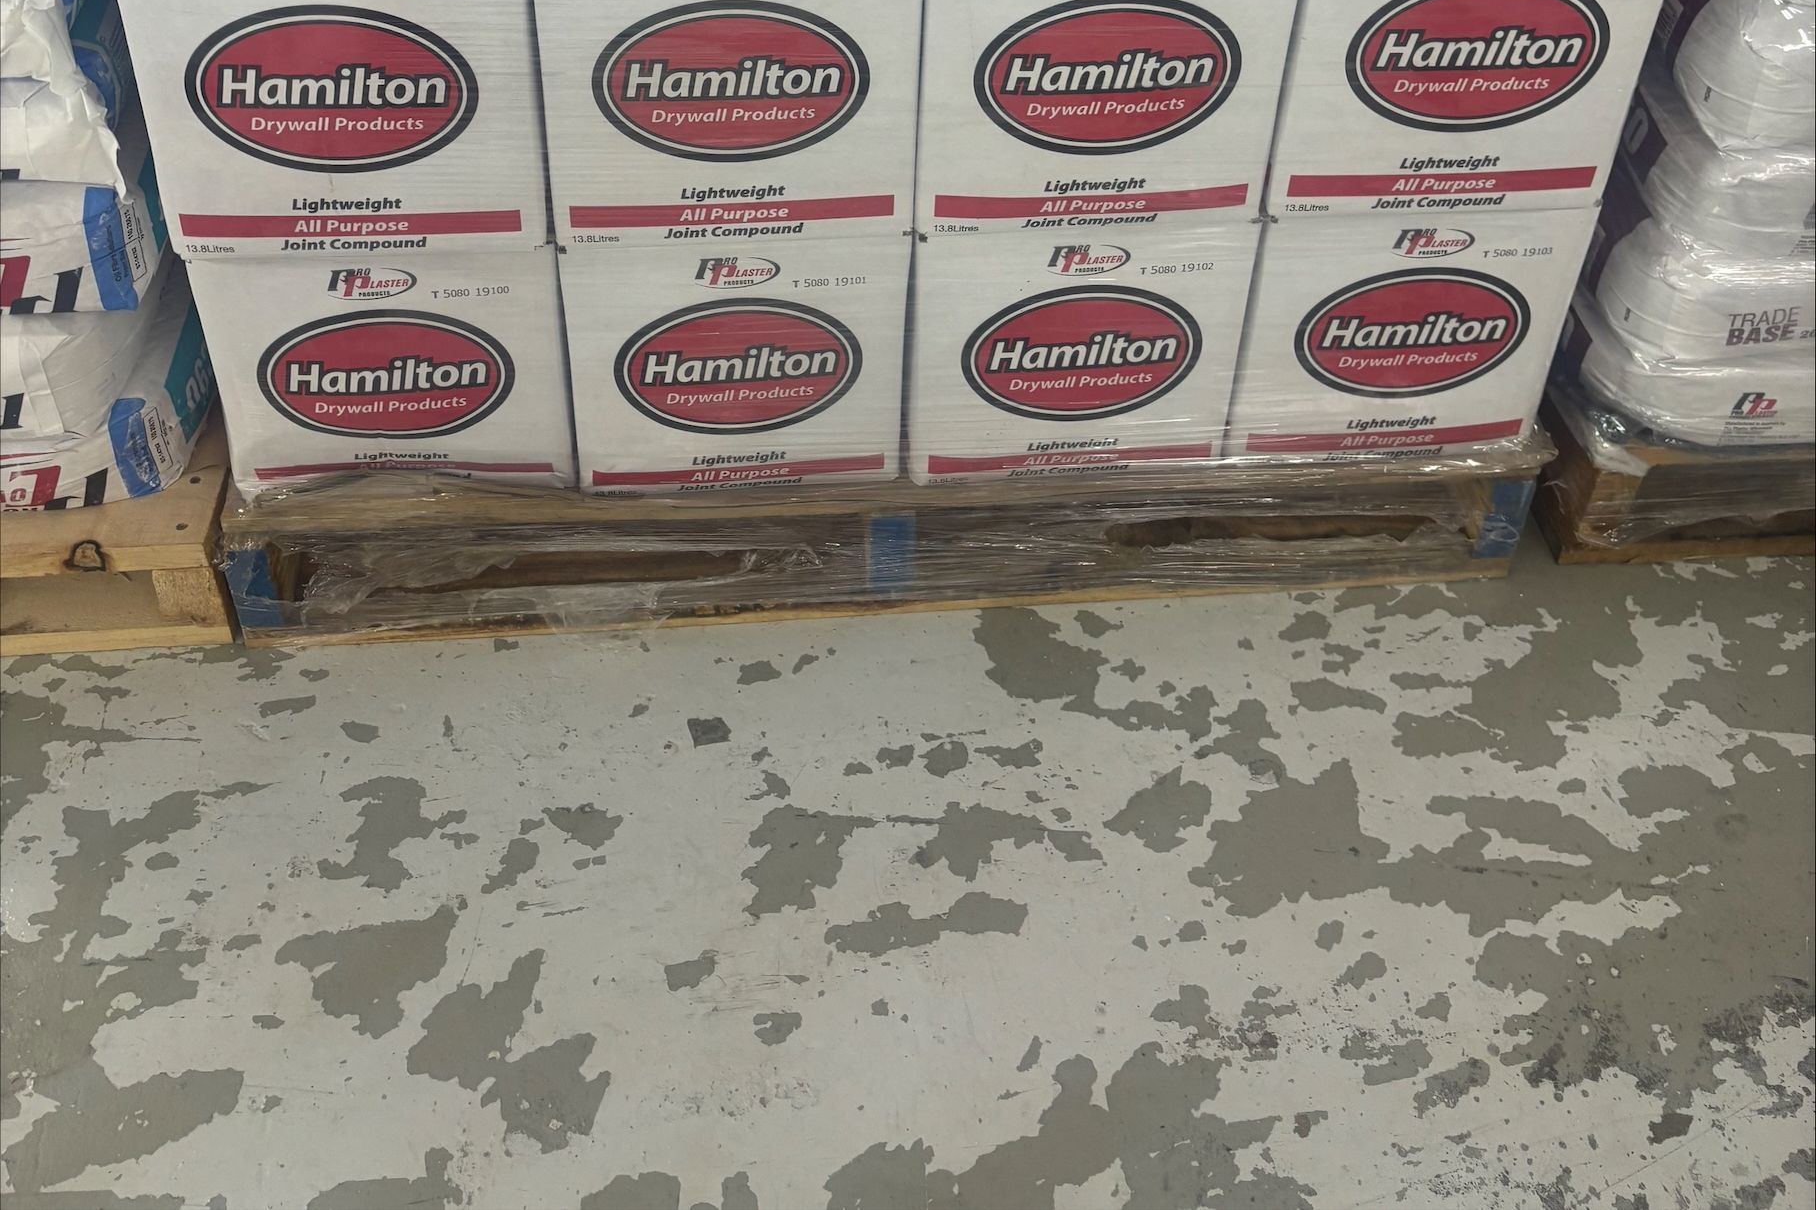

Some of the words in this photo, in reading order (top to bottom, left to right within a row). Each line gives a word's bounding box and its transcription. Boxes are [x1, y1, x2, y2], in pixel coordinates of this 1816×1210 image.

[1375, 28, 1584, 69] Hamilton
[623, 58, 842, 100] Hamilton
[1003, 52, 1214, 93] Hamilton
[219, 65, 448, 107] Hamilton
[1394, 78, 1465, 96] Drywall
[1470, 76, 1550, 92] Products
[651, 108, 726, 127] Drywall
[732, 106, 816, 121] Products
[1026, 102, 1100, 119] Drywall
[1104, 97, 1185, 114] Products
[251, 116, 329, 135] Drywall
[335, 117, 424, 132] Products
[292, 198, 402, 212] Lightweight
[294, 220, 321, 232] All
[326, 219, 409, 234] Purpose
[185, 244, 235, 254] 13.8Litres
[281, 238, 326, 251] Joint
[330, 237, 427, 251] Compound
[1140, 267, 1147, 275] T
[1151, 264, 1176, 275] 5080
[1181, 262, 1214, 273] 19102
[431, 291, 439, 299] T
[443, 288, 470, 299] 5080
[475, 286, 509, 297] 19100
[793, 280, 799, 288] T
[804, 276, 829, 287] 5080
[835, 276, 866, 287] 19101
[1728, 306, 1802, 328] TRADE
[1321, 313, 1509, 350] Hamilton
[1725, 324, 1798, 346] BASE
[989, 333, 1178, 372] Hamilton
[1338, 355, 1403, 370] Drywall
[1407, 351, 1478, 366] Products
[643, 346, 838, 385] Hamilton
[289, 359, 487, 395] Hamilton
[1009, 376, 1075, 392] Drywall
[1079, 372, 1152, 388] Products
[666, 390, 735, 406] Drywall
[738, 385, 814, 401] Products
[315, 401, 384, 418] Drywall
[389, 397, 467, 413] Products
